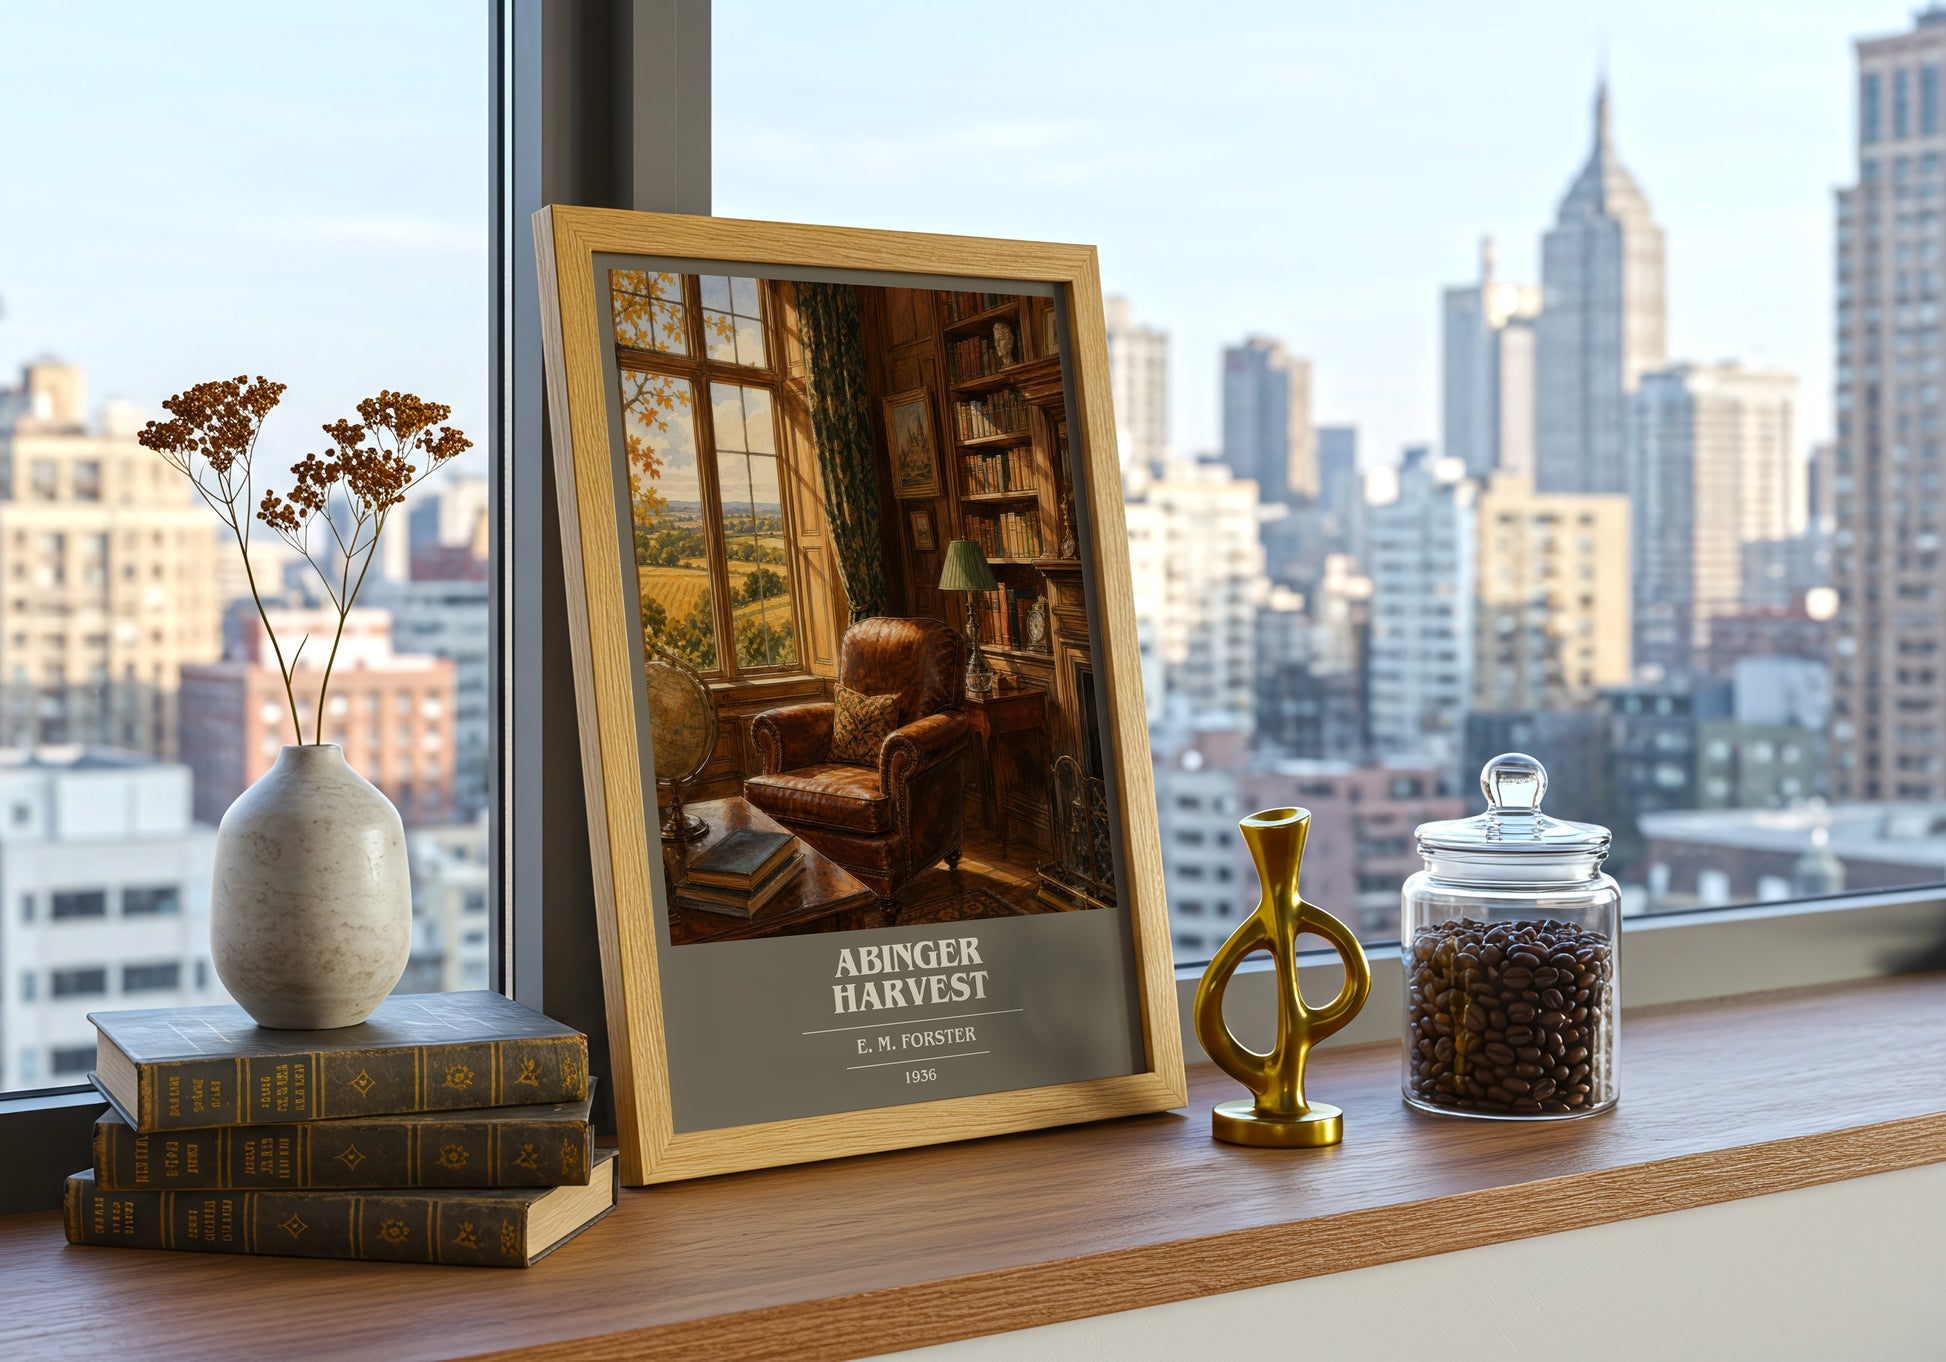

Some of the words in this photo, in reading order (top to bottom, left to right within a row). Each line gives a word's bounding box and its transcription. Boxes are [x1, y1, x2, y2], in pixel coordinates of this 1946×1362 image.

[834, 937, 984, 978] ABINGER
[832, 970, 989, 1014] HARVEST
[857, 1038, 873, 1054] E.
[878, 1036, 897, 1051] M.
[901, 1026, 977, 1049] FORSTER
[905, 1068, 937, 1084] 1936
